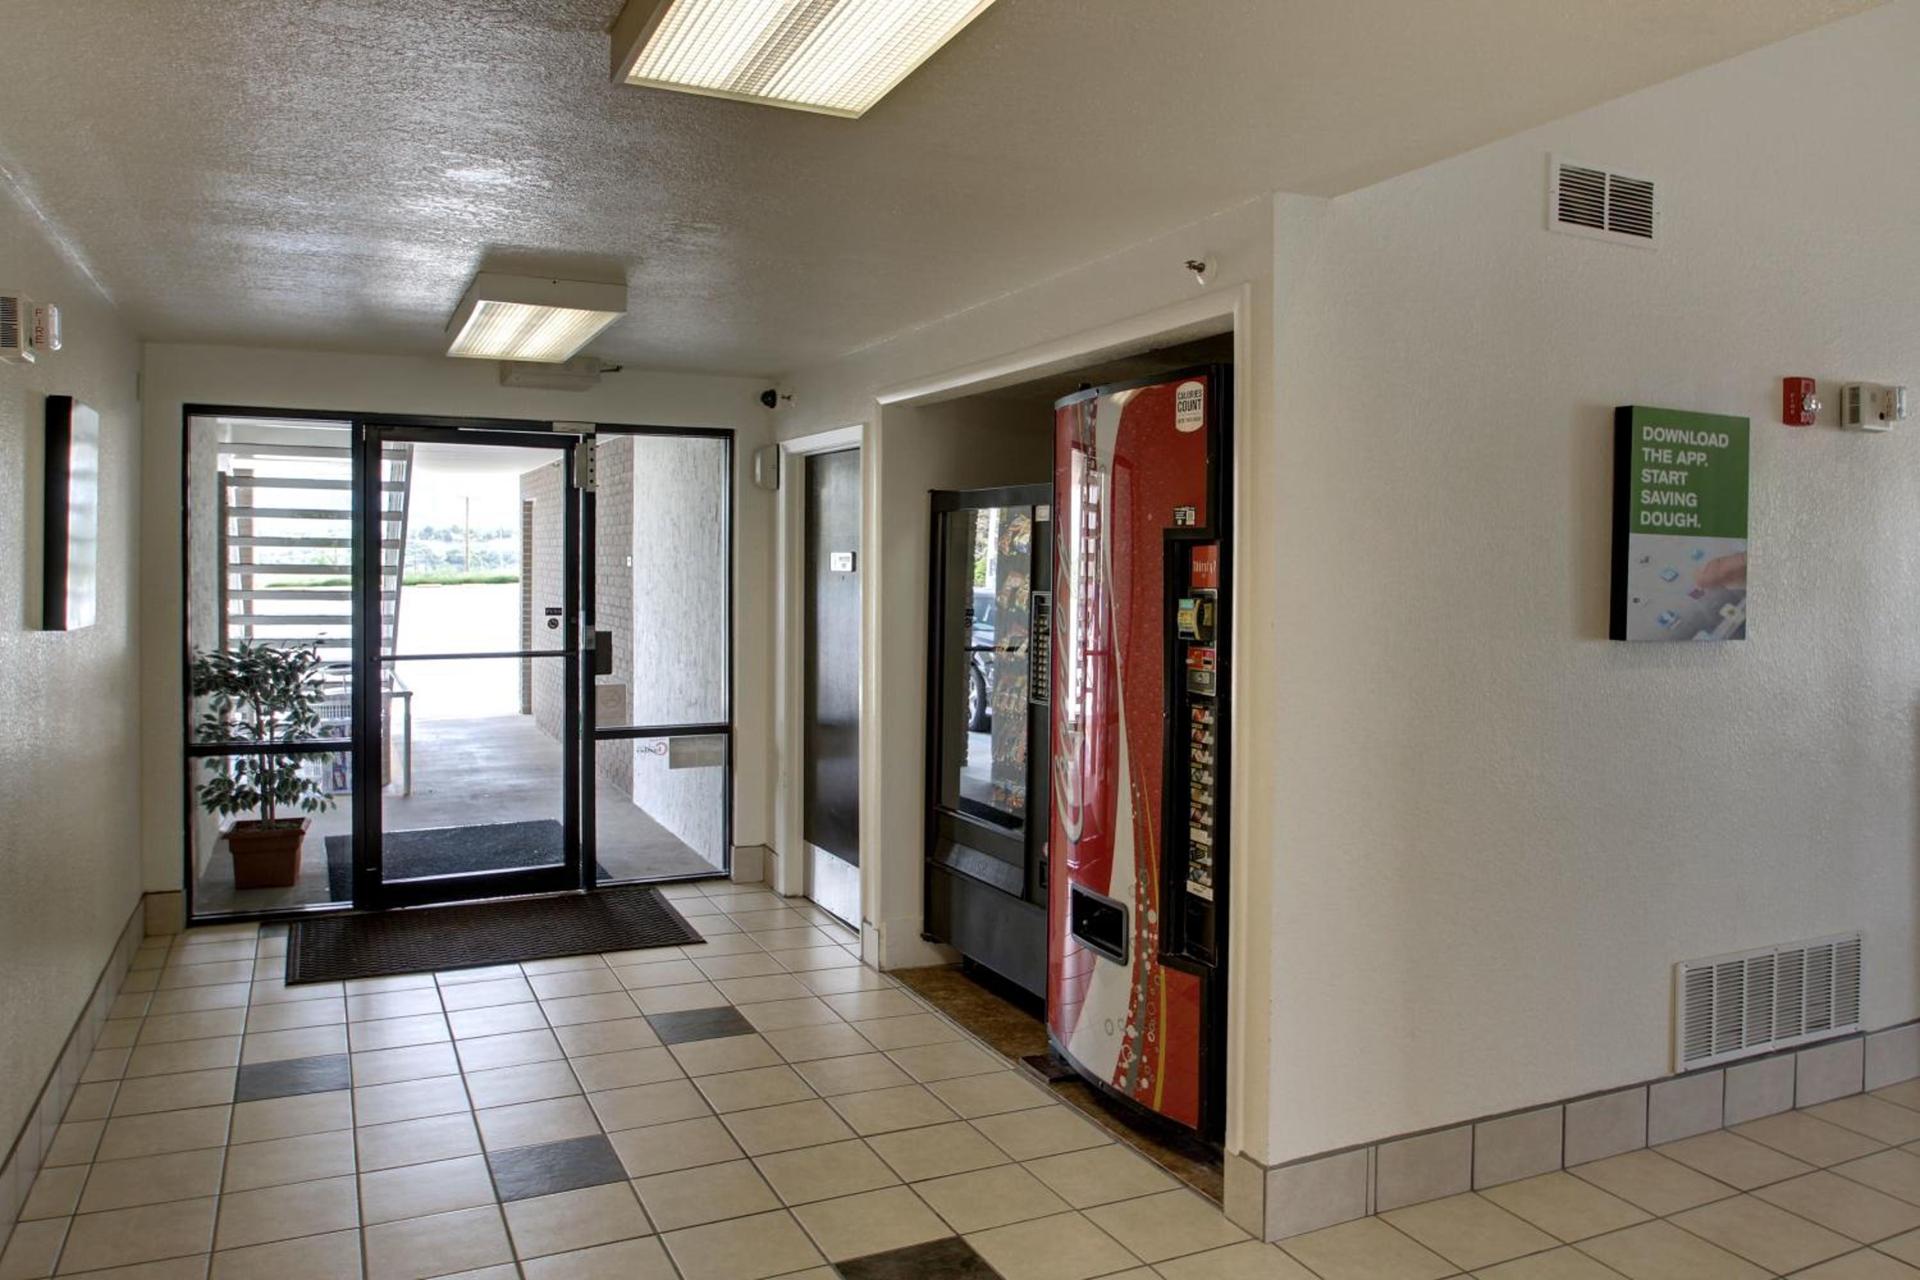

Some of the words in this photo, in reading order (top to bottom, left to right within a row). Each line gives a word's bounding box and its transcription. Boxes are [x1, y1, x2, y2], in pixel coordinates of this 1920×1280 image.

[35, 308, 44, 344] FIRE
[1177, 399, 1202, 412] COUNT
[1642, 426, 1729, 448] DOWNLOAD
[1642, 447, 1672, 464] THE
[1676, 449, 1709, 467] APP.
[1641, 469, 1688, 485] START
[1640, 489, 1698, 508] SAVING
[1640, 511, 1701, 529] DOUGH.
